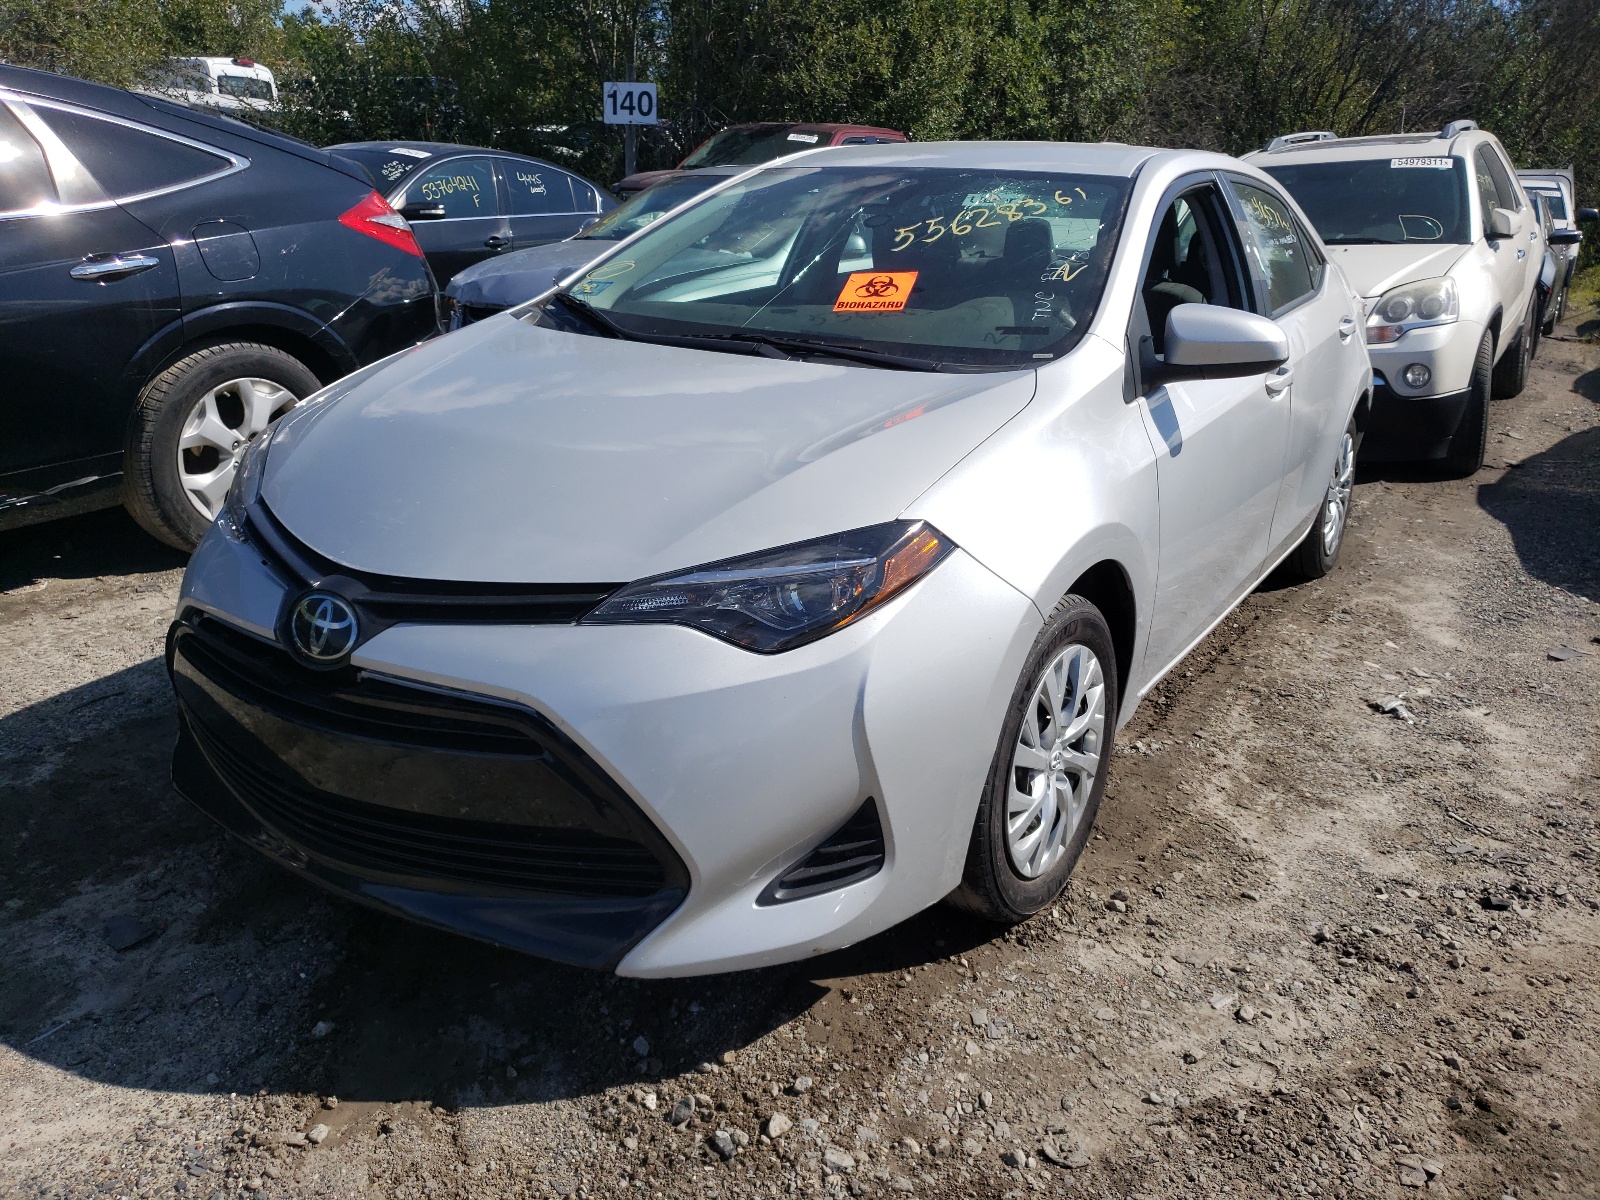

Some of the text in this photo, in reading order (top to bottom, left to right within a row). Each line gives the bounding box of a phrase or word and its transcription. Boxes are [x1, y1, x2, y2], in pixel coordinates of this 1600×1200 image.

[607, 90, 654, 117] 140
[422, 175, 480, 201] 53764241
[472, 193, 480, 208] F
[836, 301, 904, 309] BIOHAZARD
